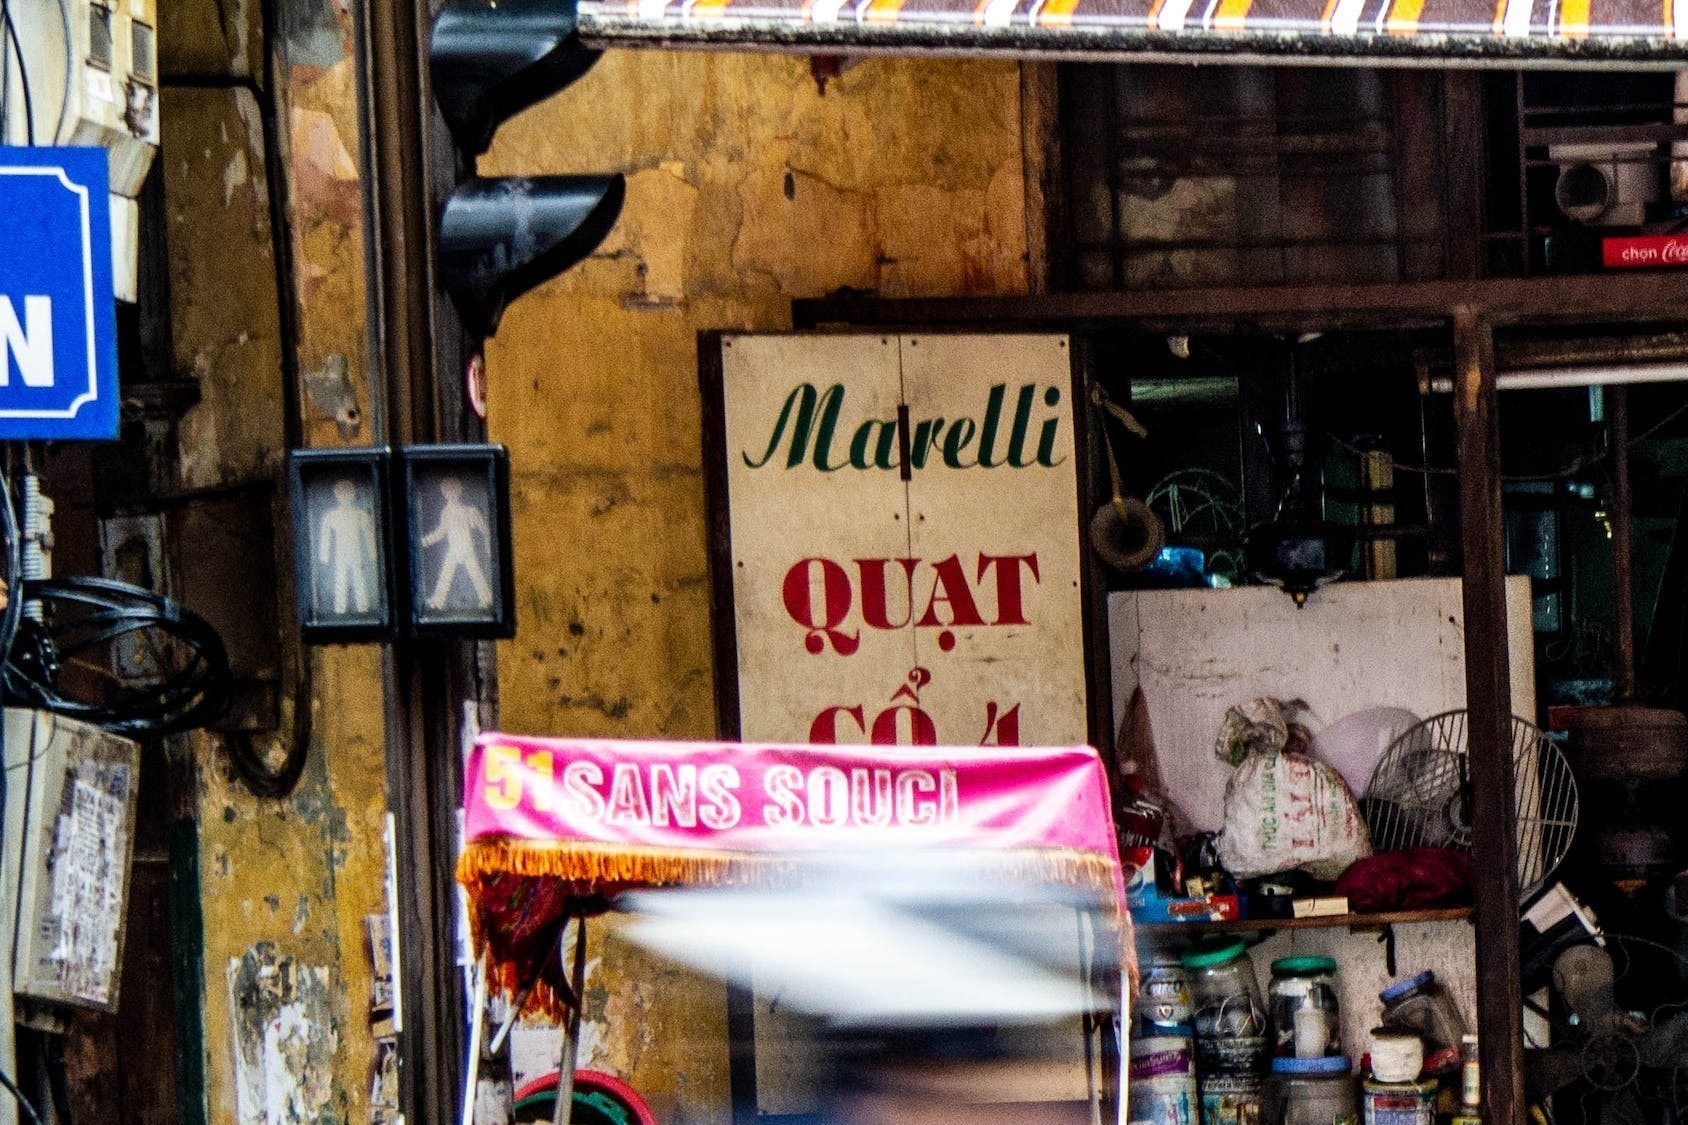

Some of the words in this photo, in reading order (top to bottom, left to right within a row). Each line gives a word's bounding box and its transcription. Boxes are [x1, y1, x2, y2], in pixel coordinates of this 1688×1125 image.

[742, 382, 1067, 472] Marelli
[782, 551, 1040, 657] QUẠT
[563, 761, 742, 829] SANS
[763, 764, 959, 829] SOUCI
